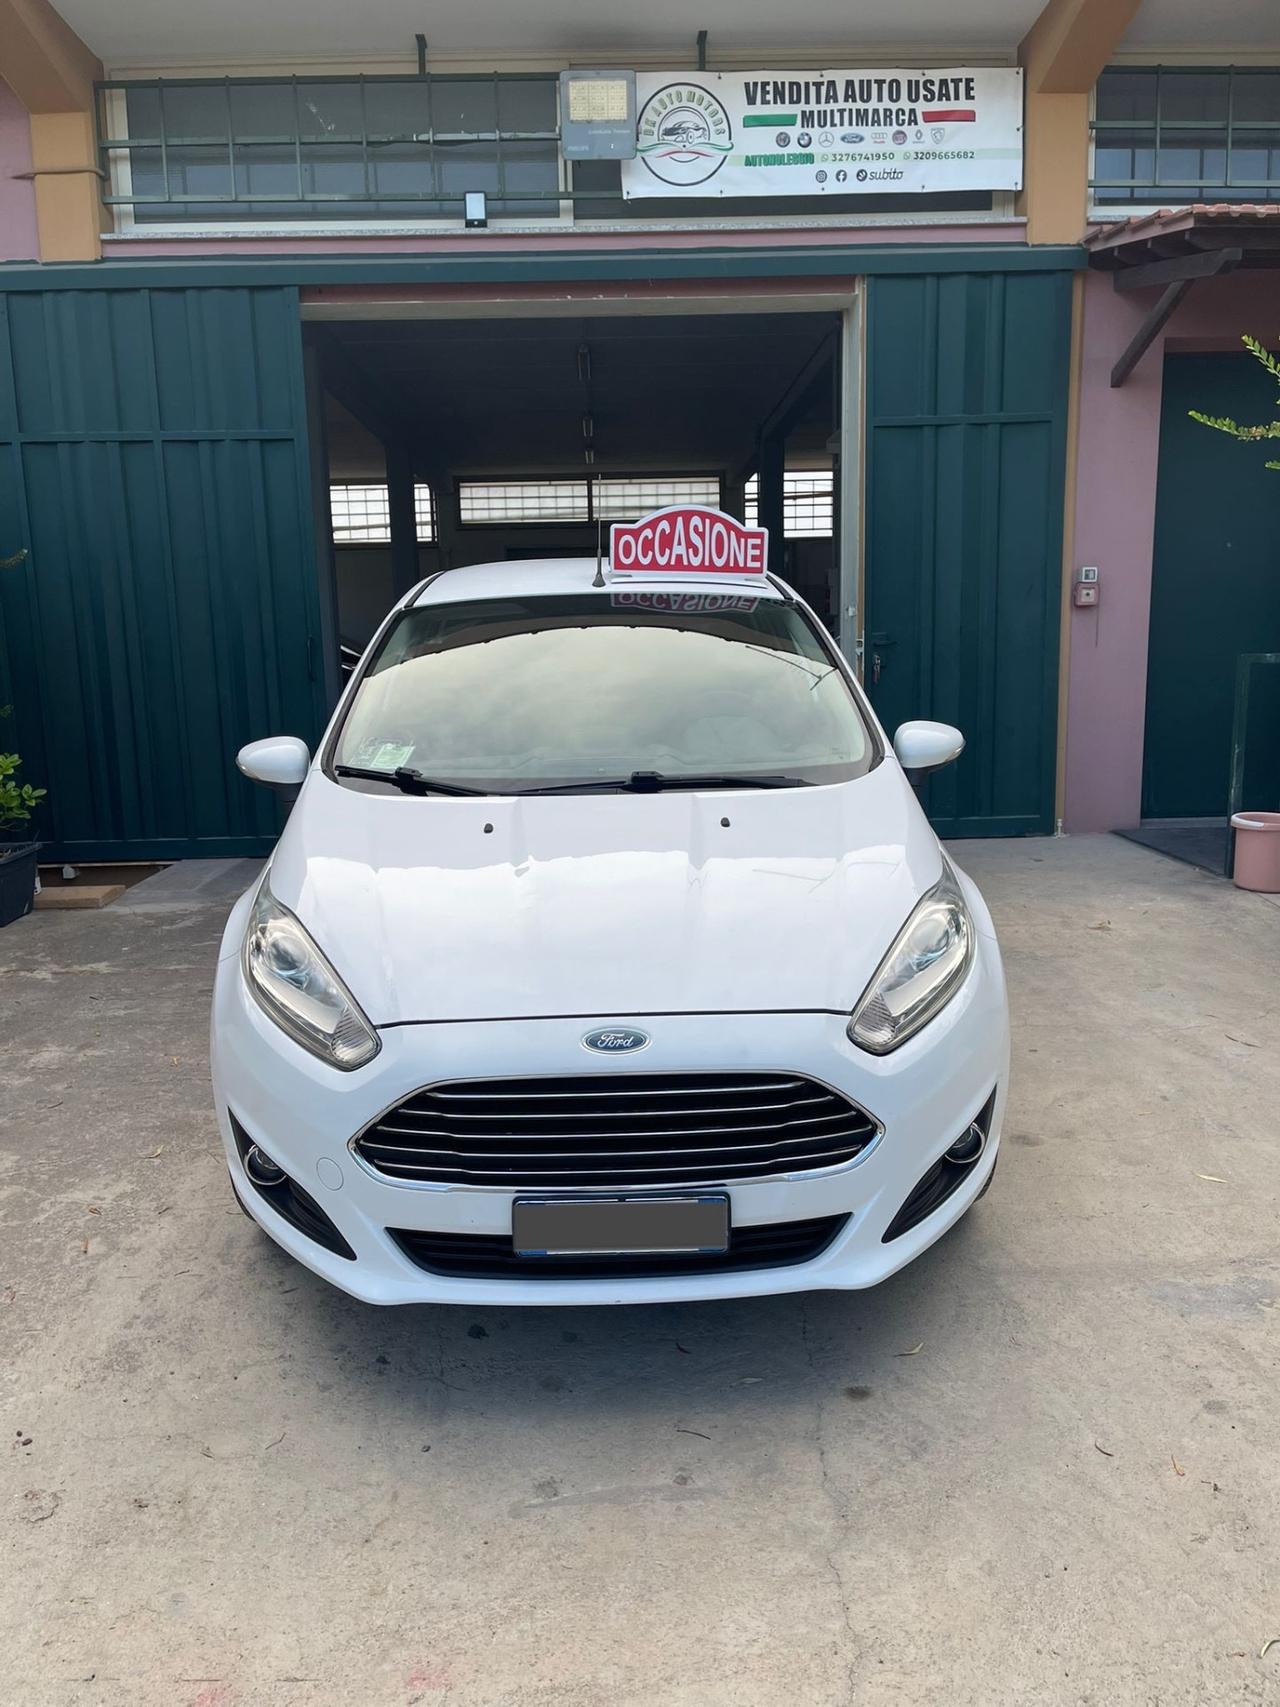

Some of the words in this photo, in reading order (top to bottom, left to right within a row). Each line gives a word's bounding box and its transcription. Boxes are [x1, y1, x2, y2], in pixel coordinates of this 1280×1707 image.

[744, 80, 839, 106] VENDITA
[843, 78, 902, 103] AUTO
[907, 77, 976, 103] USATE
[651, 90, 683, 117] AUTO
[686, 90, 726, 135] MOTORS
[801, 107, 919, 128] MULTIMARCA
[744, 152, 815, 167] AUTONOLEGGIO
[831, 152, 895, 162] 3276741950
[913, 151, 975, 161] 3209665682
[868, 167, 904, 181] subito
[618, 515, 762, 568] OCCASIONE
[597, 1032, 634, 1048] Ford
